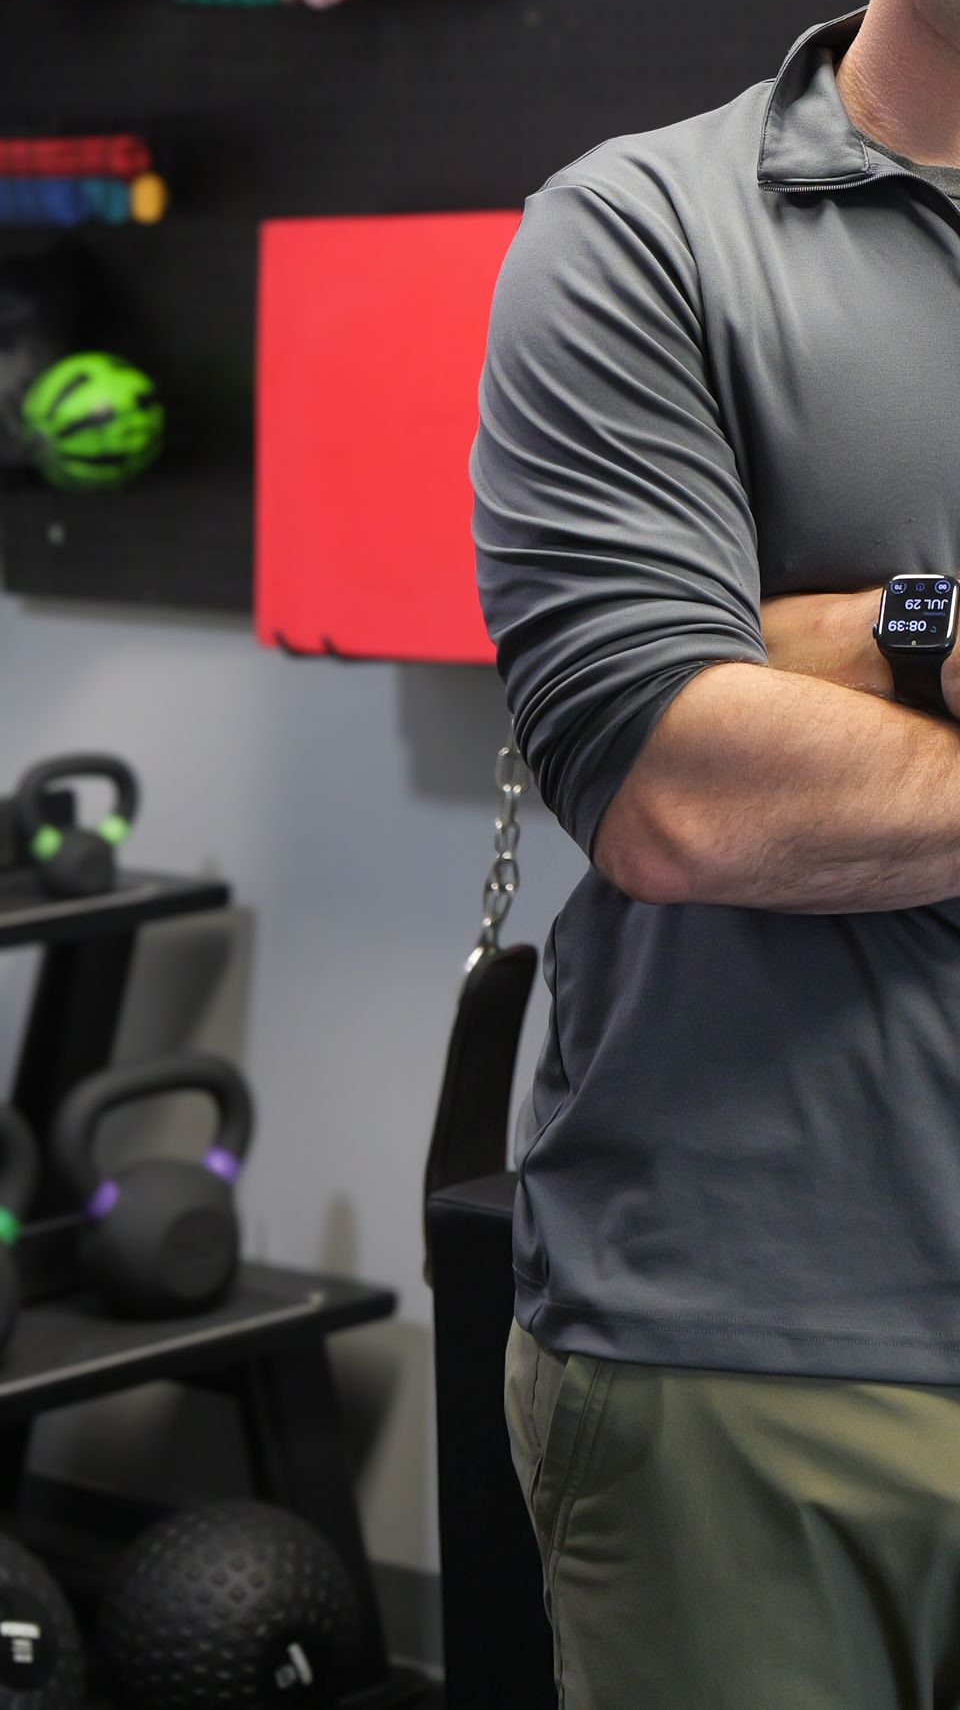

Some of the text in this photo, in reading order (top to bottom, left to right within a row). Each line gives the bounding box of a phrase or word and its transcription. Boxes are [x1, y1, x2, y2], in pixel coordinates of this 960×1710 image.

[905, 599, 949, 610] JUL 29
[888, 620, 927, 631] 08:39
